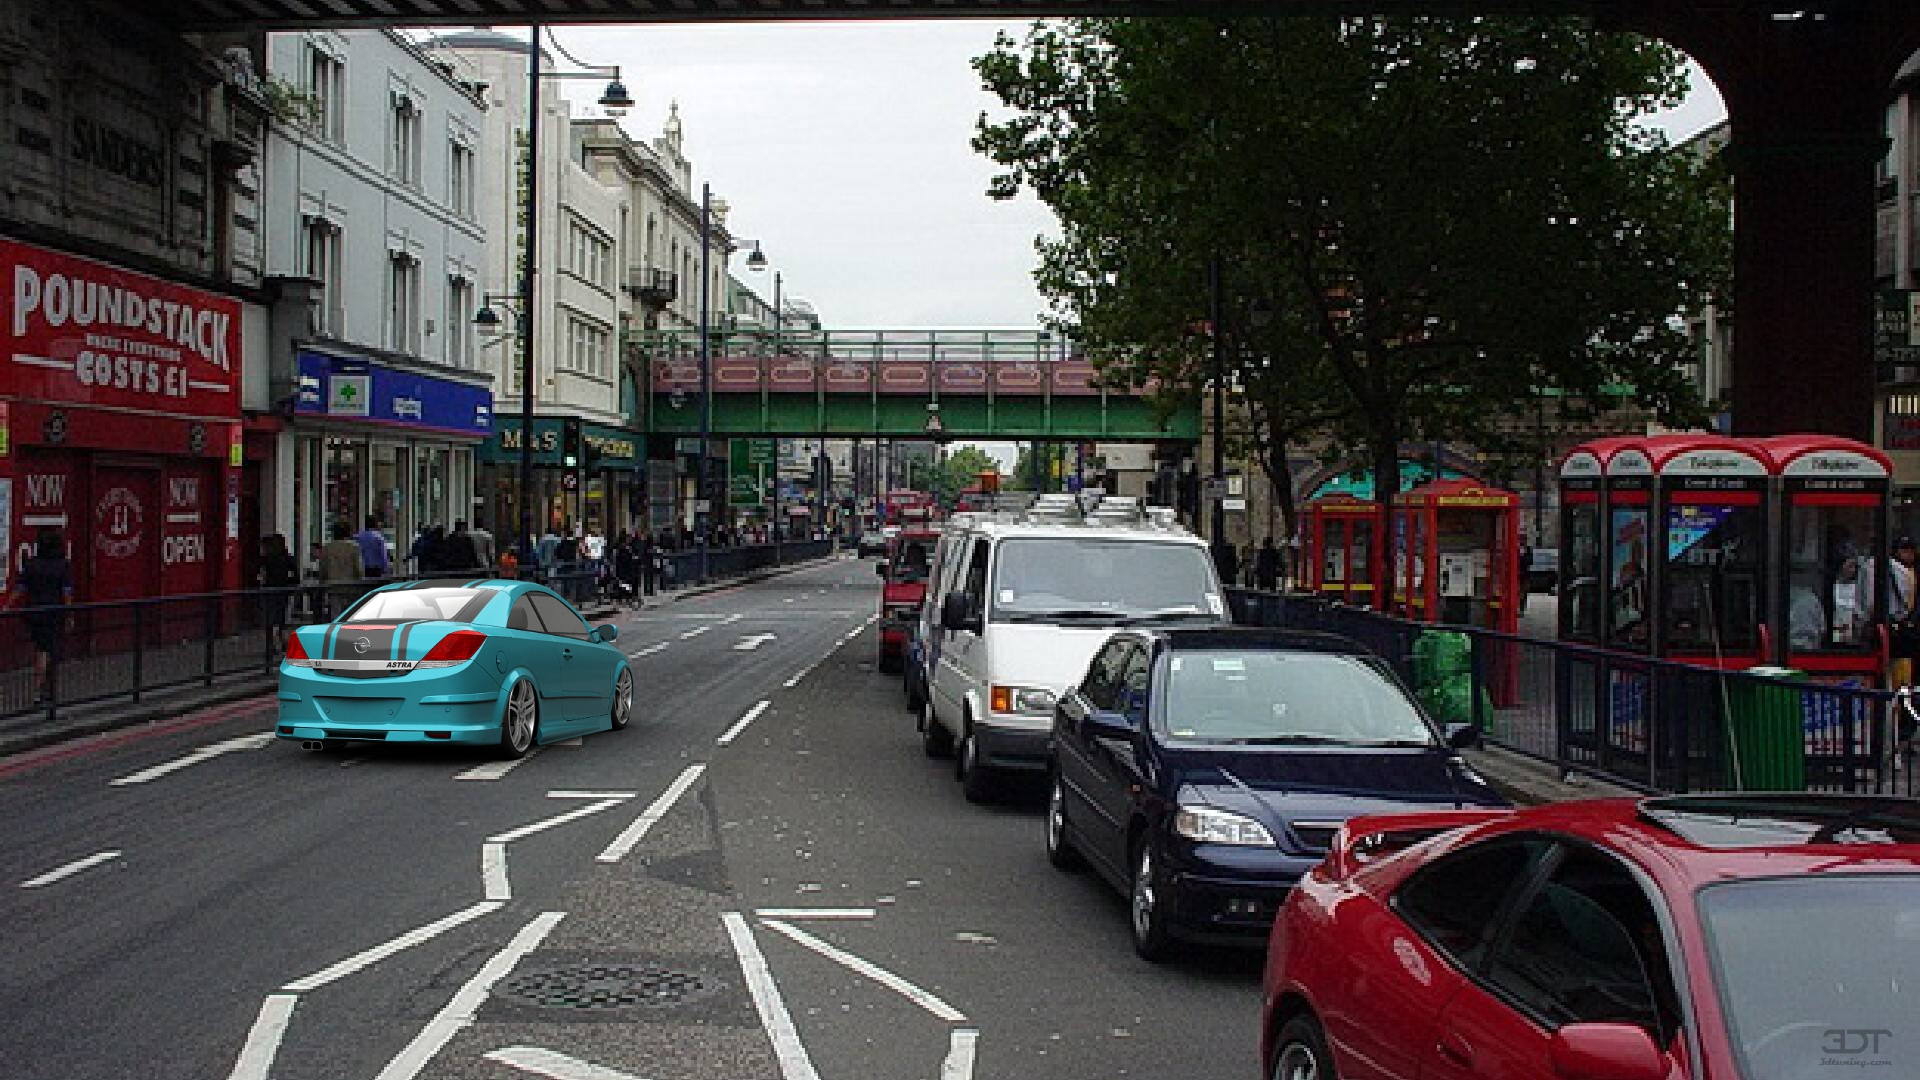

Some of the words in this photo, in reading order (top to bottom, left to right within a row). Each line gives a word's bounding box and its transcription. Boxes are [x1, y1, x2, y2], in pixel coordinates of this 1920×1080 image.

[13, 264, 230, 372] POUNDSTACK
[25, 474, 66, 507] NOW
[162, 533, 205, 564] OPEN
[386, 661, 413, 669] ASTRA
